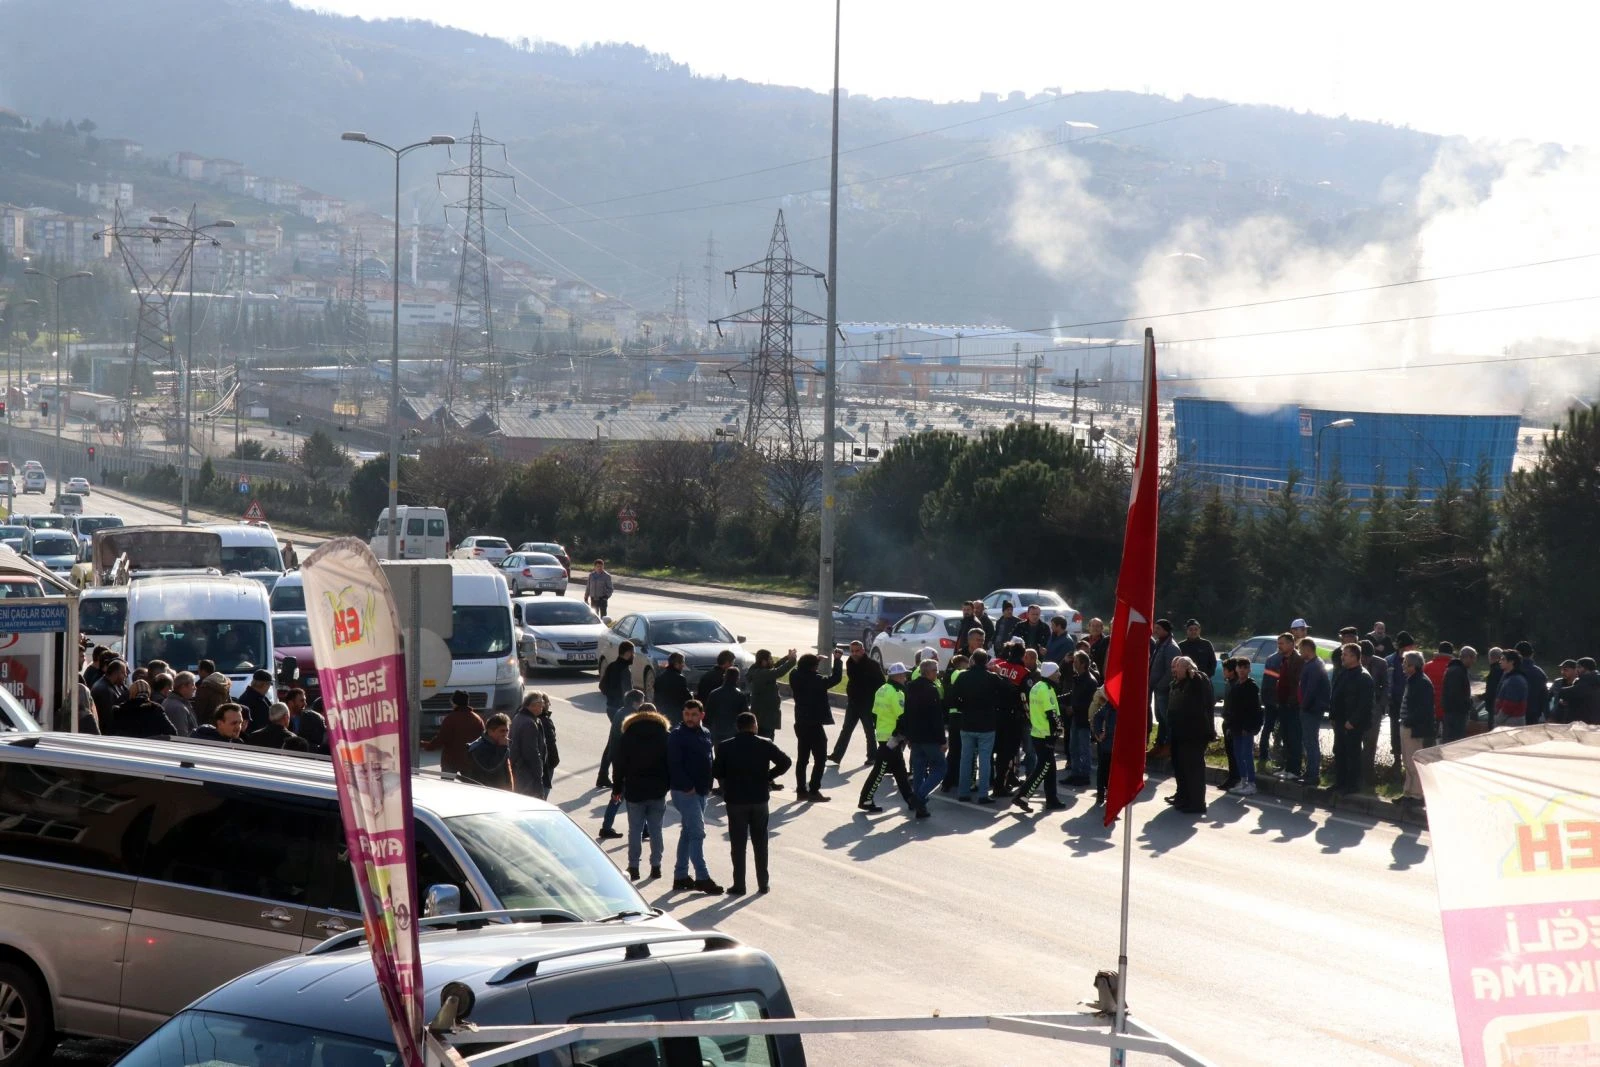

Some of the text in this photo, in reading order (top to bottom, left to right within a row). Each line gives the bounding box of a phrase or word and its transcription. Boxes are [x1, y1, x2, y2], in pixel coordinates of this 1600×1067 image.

[11, 606, 40, 620] ÇAĞLAR
[41, 607, 65, 618] SOKAK
[1000, 667, 1018, 680] OLİS
